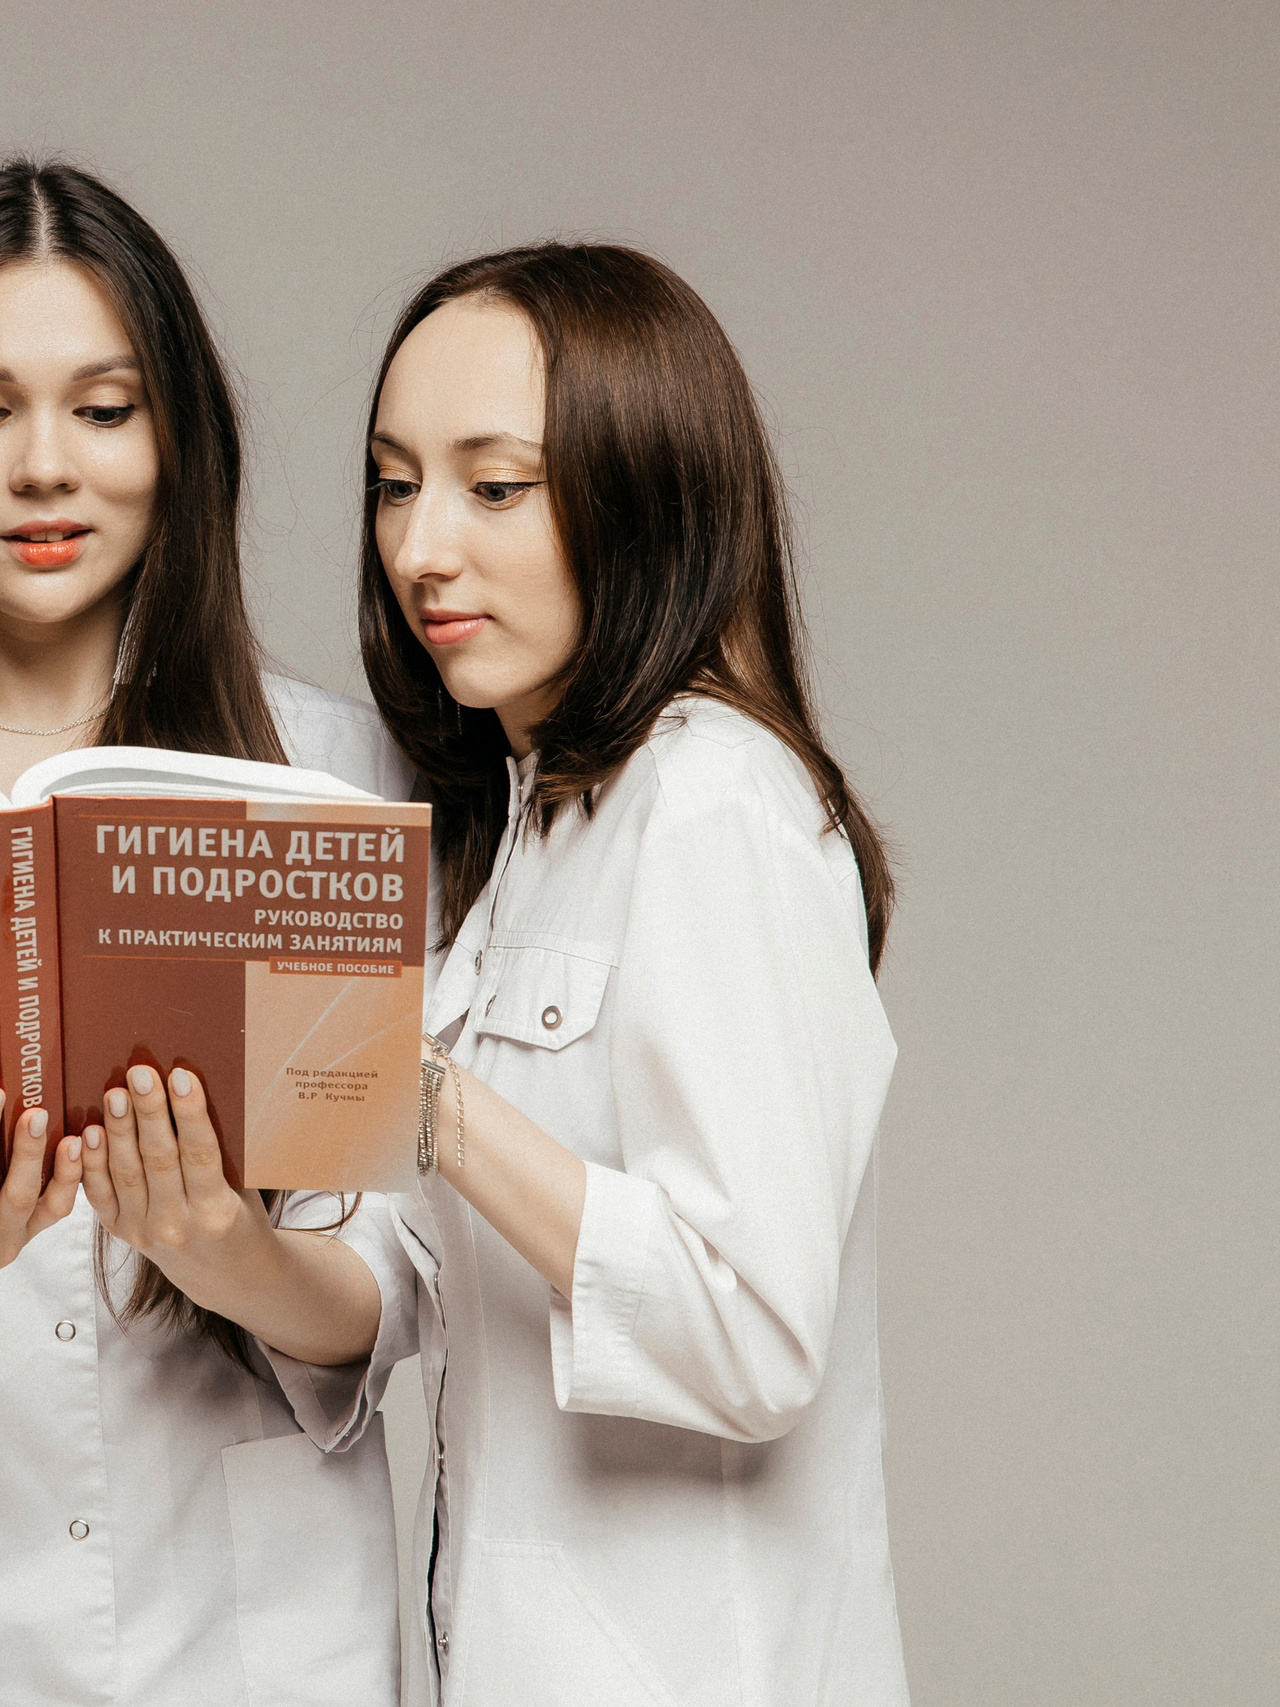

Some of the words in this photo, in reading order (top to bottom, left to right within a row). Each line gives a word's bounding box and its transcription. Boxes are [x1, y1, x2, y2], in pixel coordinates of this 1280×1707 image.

[96, 825, 273, 859] ГИГИЕНА
[285, 827, 405, 866] ДЕТЕЙ
[10, 826, 36, 913] ГИГИЕНА
[112, 865, 136, 894] И
[153, 866, 404, 903] ПОДРОСТКОВ
[254, 909, 404, 931] РУКОВОДСТВО
[10, 916, 42, 973] ДЕТЕЙ
[98, 928, 112, 944] К
[119, 929, 283, 950] ПРАКТИЧЕСКИМ
[289, 933, 402, 953] ЗАНЯТИЯМ
[277, 961, 333, 972] УЧЕБНОЕ
[337, 963, 395, 974] ПОСОБИЕ
[17, 976, 39, 991] И
[15, 994, 43, 1109] ПОДРОСТКОВ
[286, 1067, 309, 1077] Под
[313, 1070, 378, 1078] редакцией
[295, 1080, 368, 1091] профессора
[326, 1092, 365, 1102] Кучмы
